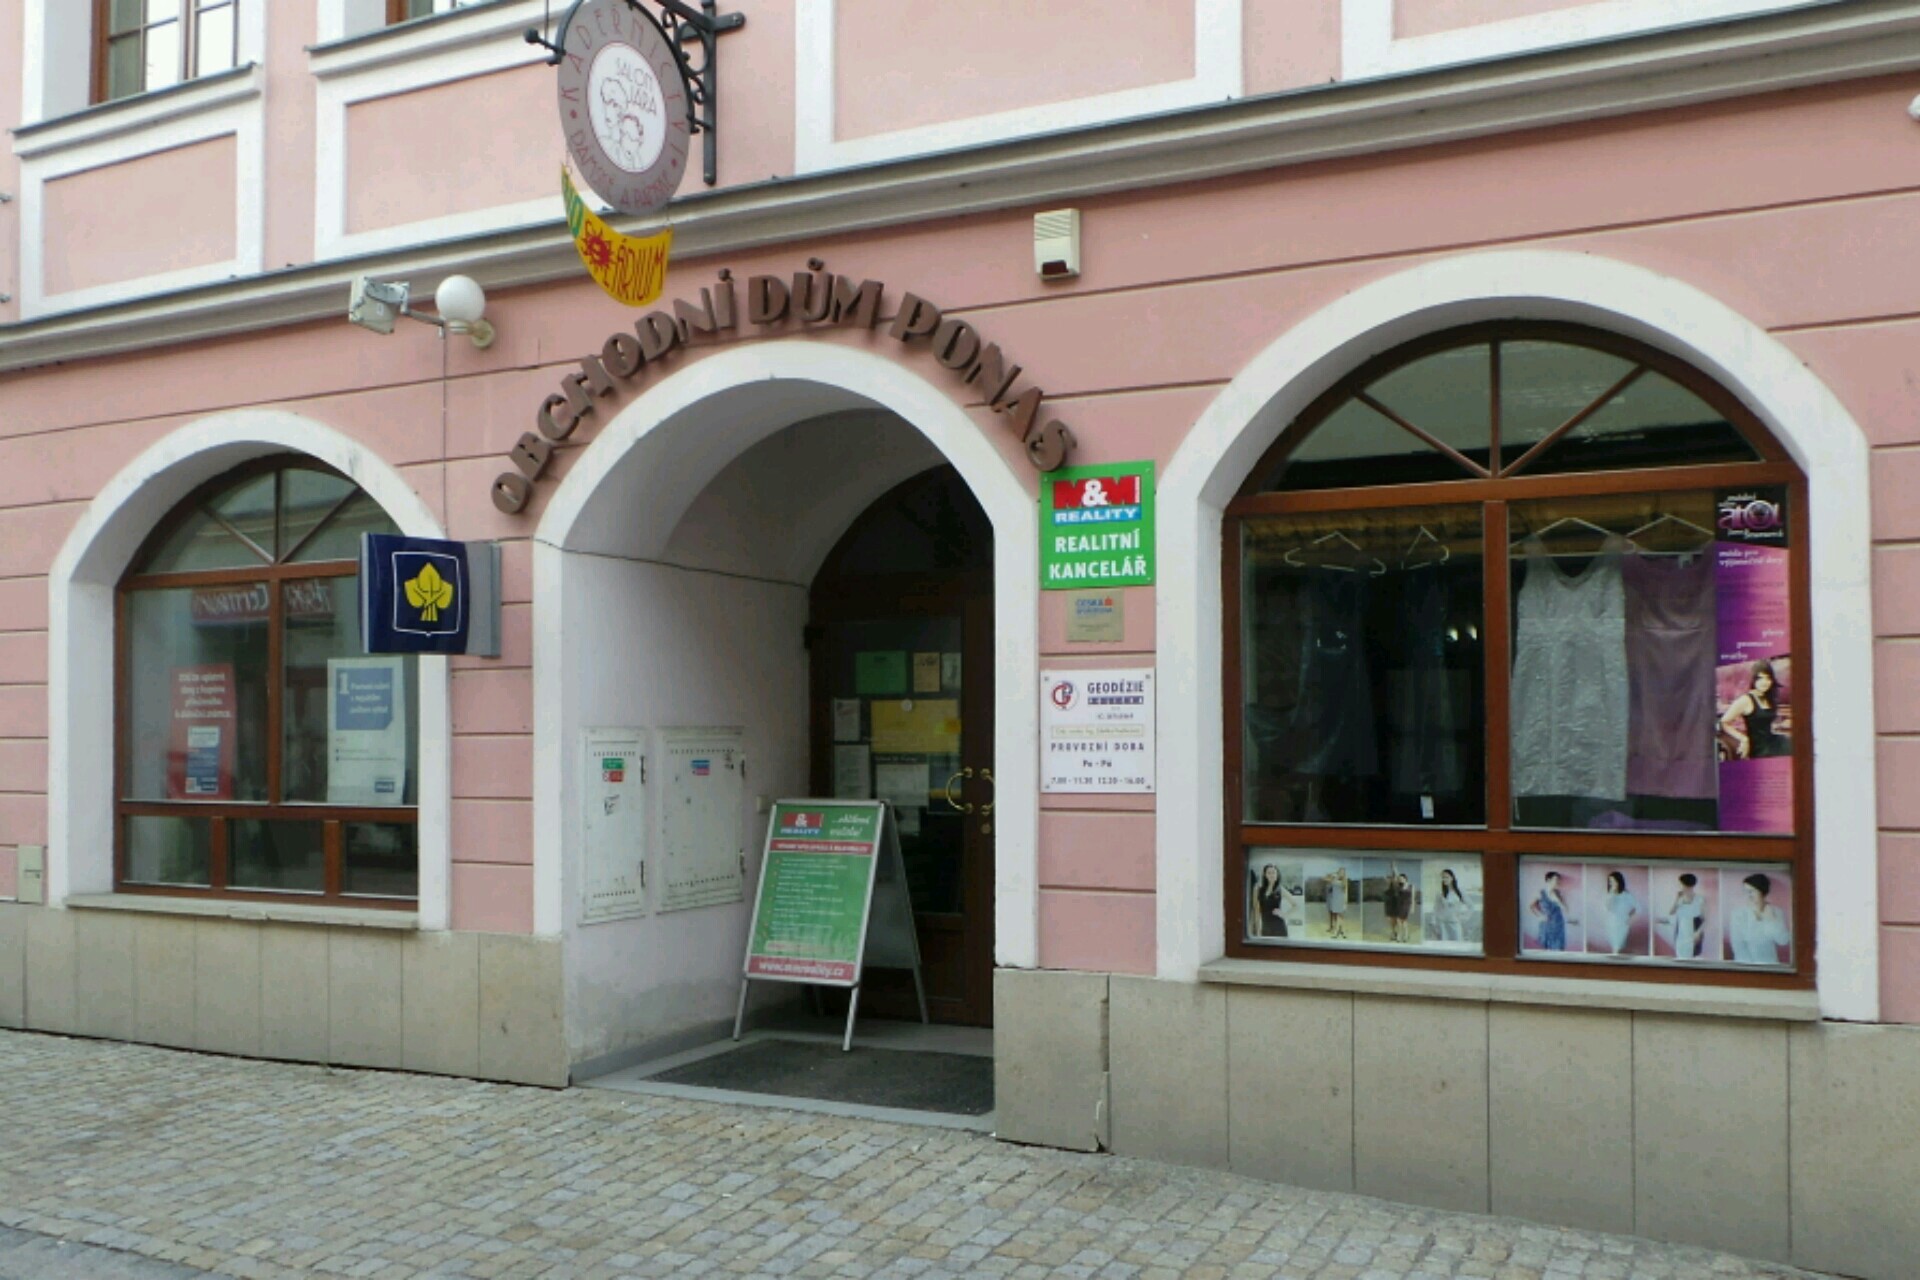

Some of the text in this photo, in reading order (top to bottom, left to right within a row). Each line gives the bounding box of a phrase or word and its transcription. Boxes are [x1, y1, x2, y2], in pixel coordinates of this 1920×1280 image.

[491, 257, 1077, 515] OBCHODNÍ DŮM PONAS
[1054, 508, 1138, 524] REALITY
[1054, 528, 1141, 553] REALITNÍ
[1049, 554, 1147, 580] KANCELÁŘ
[1087, 678, 1145, 694] GEODÉZIE
